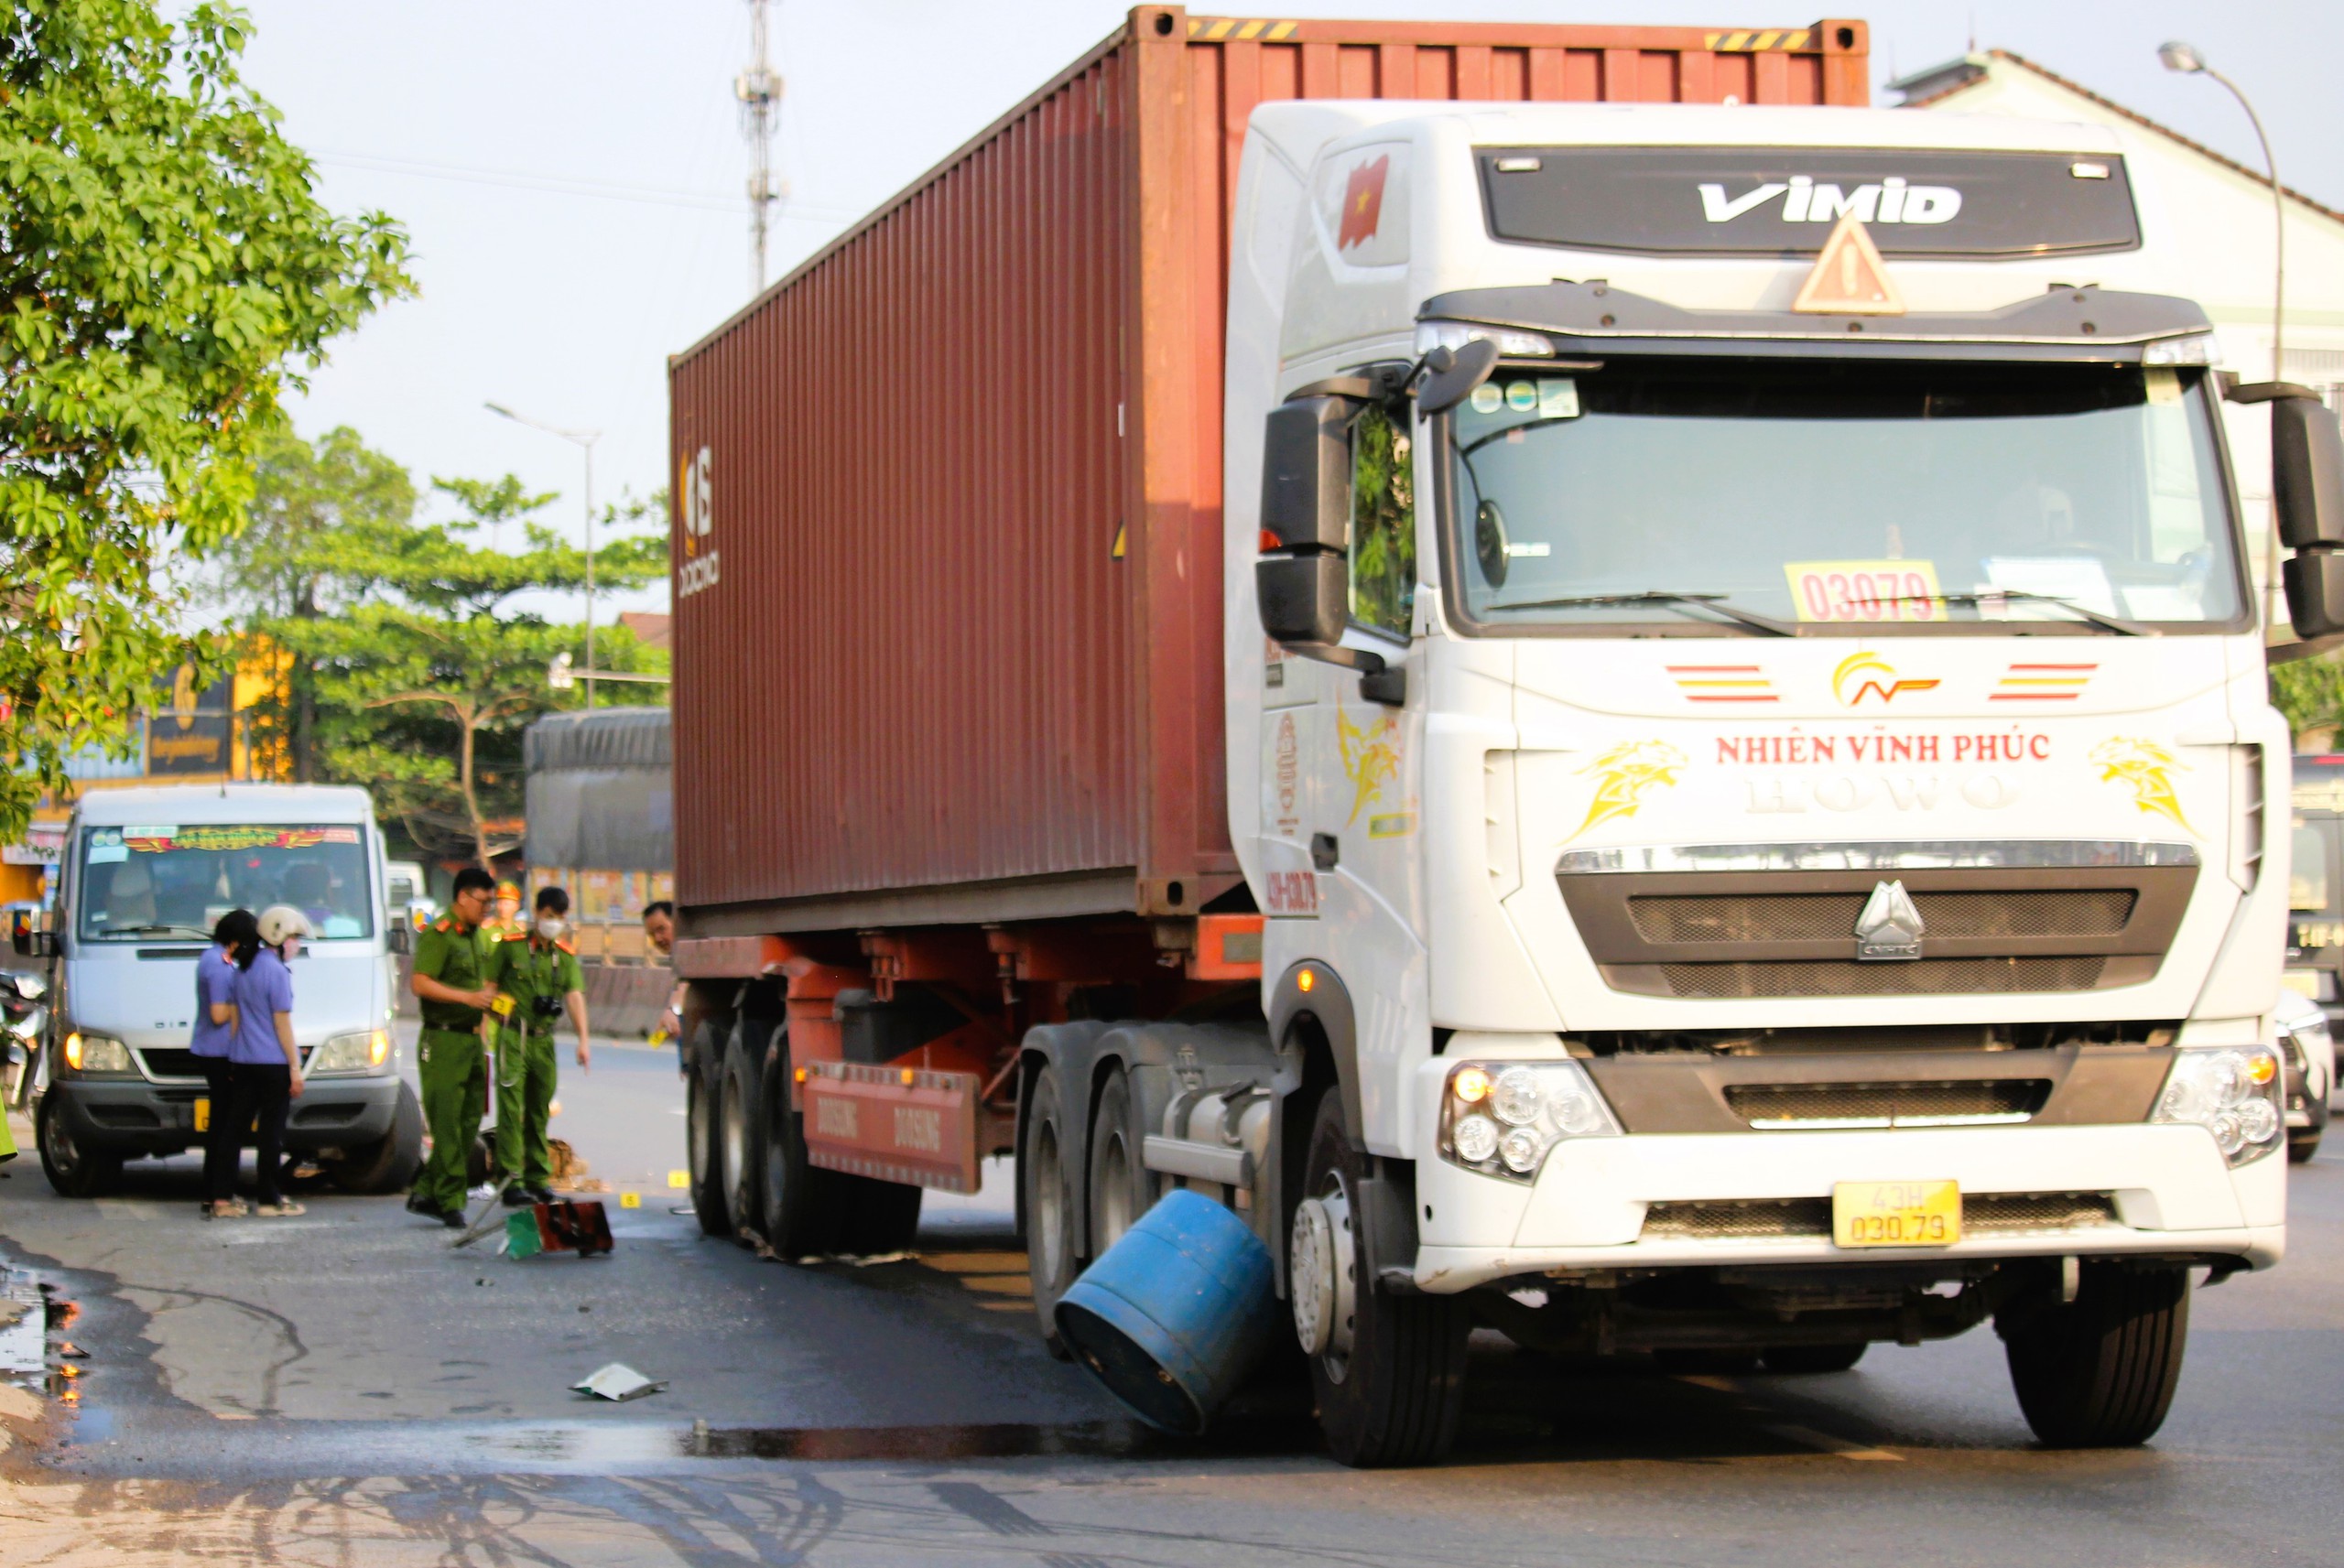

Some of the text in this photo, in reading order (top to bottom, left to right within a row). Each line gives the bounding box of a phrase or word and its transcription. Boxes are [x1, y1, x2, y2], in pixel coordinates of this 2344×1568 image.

[1801, 572, 1935, 622] 03079
[1717, 724, 2050, 763] NHIÊN VĨNH PHÚC
[1743, 773, 2022, 814] HOWO
[1872, 1185, 1924, 1211] 43H
[1851, 1214, 1946, 1240] 030.79
